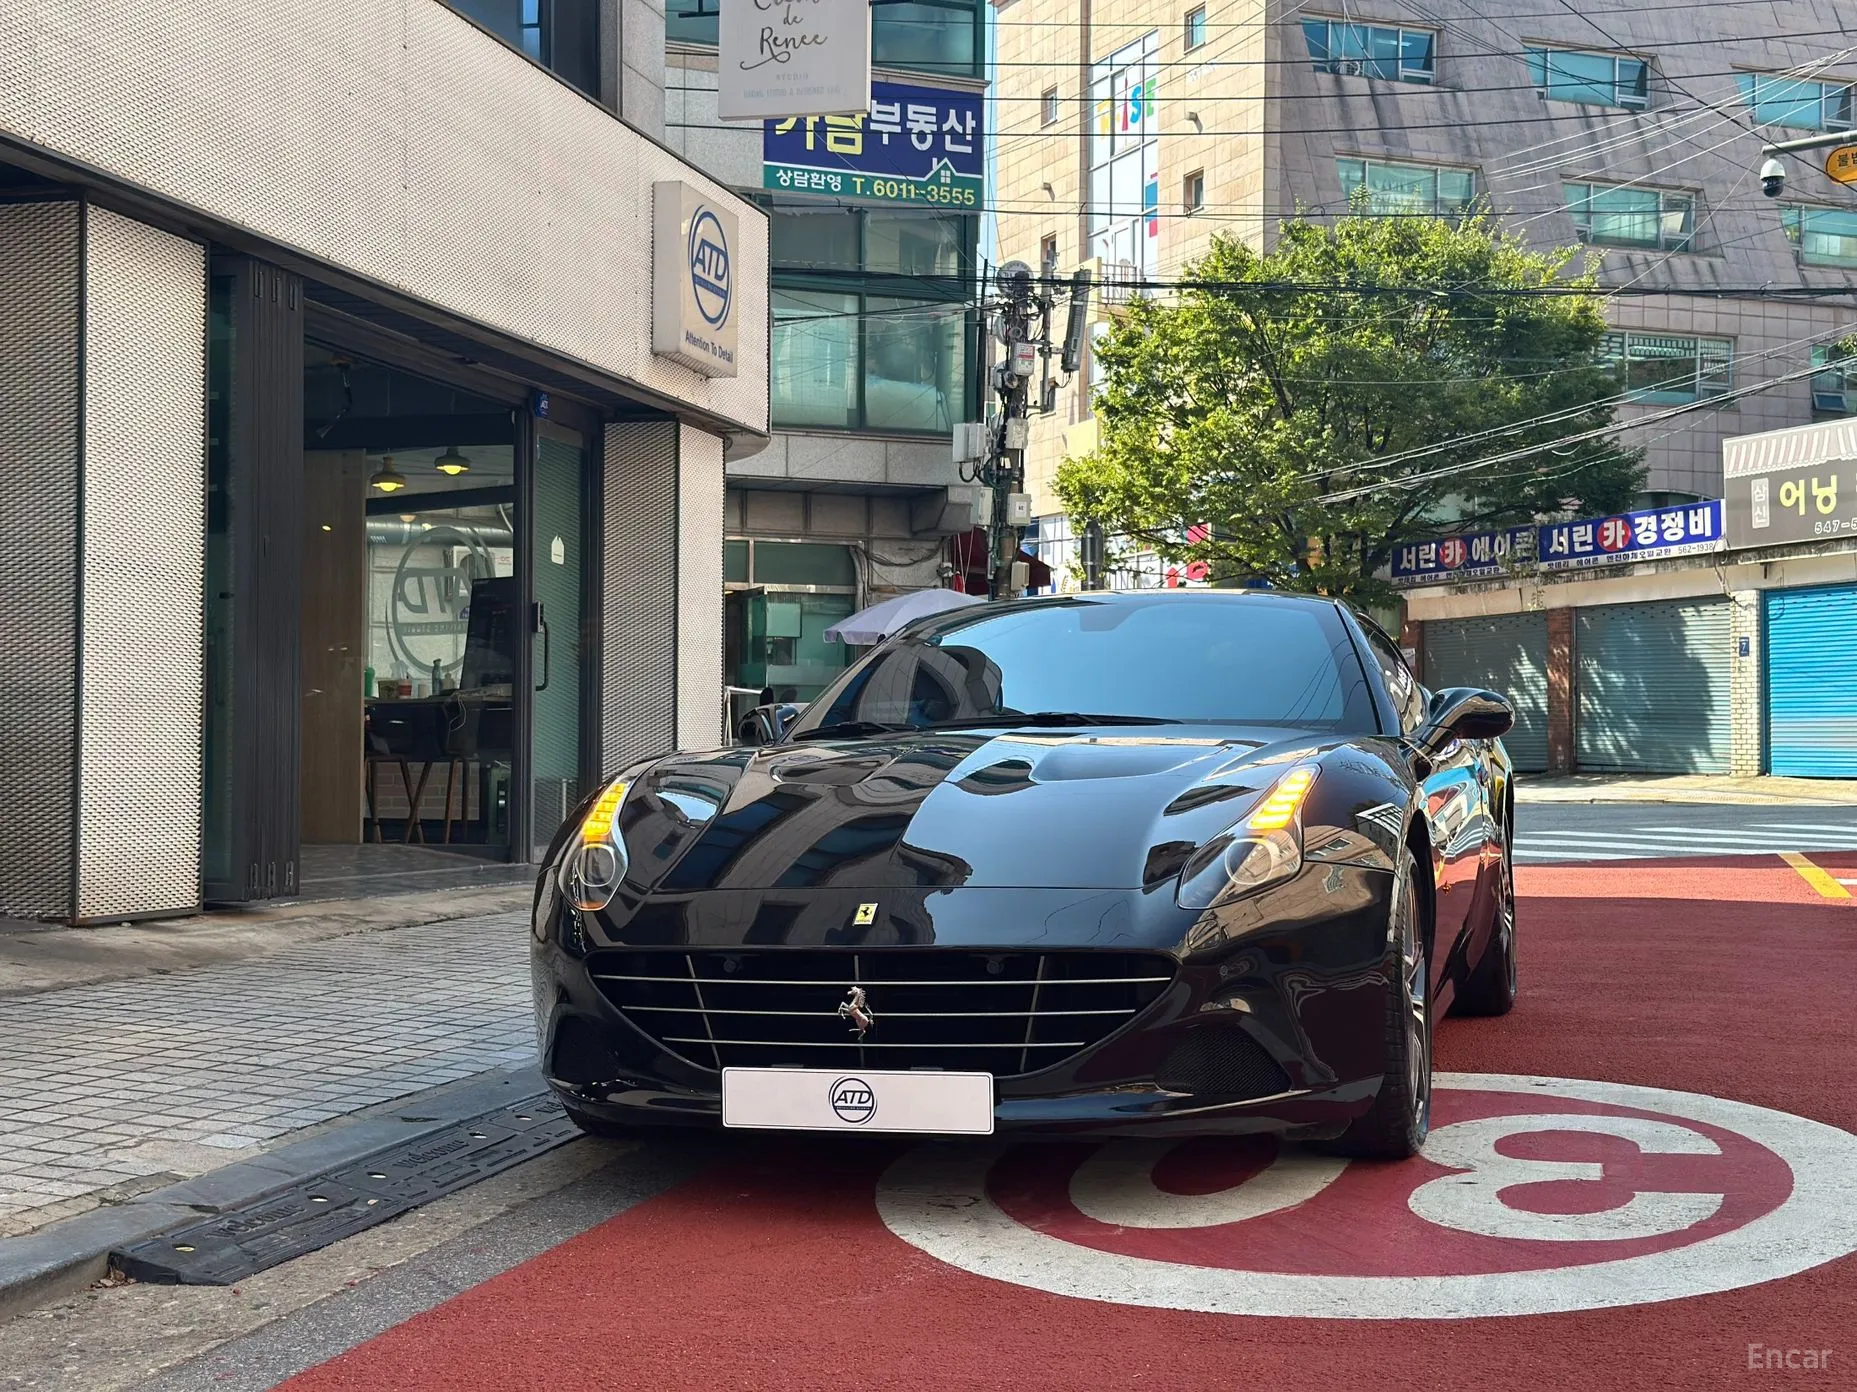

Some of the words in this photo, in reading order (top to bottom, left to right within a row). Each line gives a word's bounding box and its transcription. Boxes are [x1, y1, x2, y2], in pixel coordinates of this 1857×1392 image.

[783, 4, 804, 26] de
[740, 26, 828, 70] Renee
[775, 168, 842, 192] 상담환영
[693, 238, 729, 282] ATD
[685, 329, 710, 352] Attention
[710, 341, 718, 357] To
[718, 345, 734, 364] Detail
[1779, 474, 1838, 516] 어닝
[1548, 524, 1594, 556] 서린
[1603, 520, 1626, 549] 카
[1634, 506, 1712, 545] 경정비
[1400, 542, 1437, 571] 서린
[1443, 540, 1463, 565] 카
[834, 1089, 872, 1104] ATD
